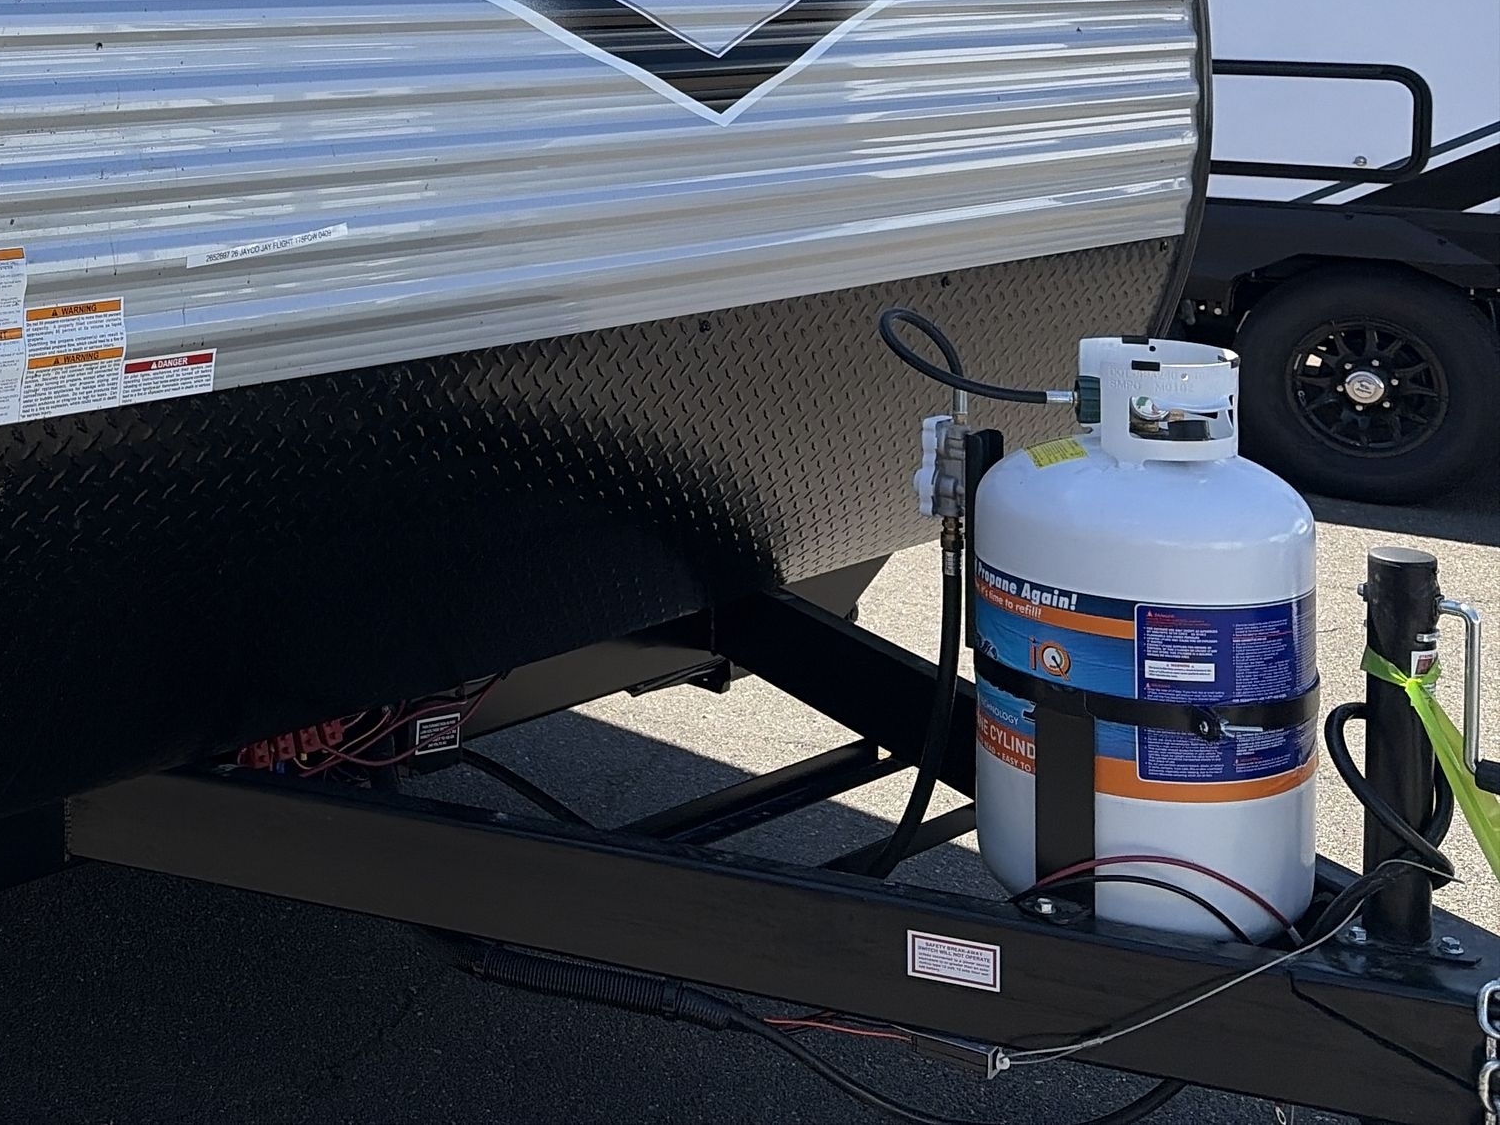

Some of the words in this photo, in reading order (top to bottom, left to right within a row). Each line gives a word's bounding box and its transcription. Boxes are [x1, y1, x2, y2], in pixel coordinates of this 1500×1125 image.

[239, 244, 260, 257] JAYCO
[260, 242, 272, 252] JAY
[273, 238, 293, 250] FLIGHT
[61, 304, 97, 315] WARNING
[64, 352, 99, 363] WARNING
[157, 356, 189, 369] DANGER
[978, 561, 1018, 595] Propane
[1021, 582, 1078, 611] Again!
[1004, 596, 1014, 610] to
[1015, 603, 1042, 619] refill!
[1002, 754, 1019, 767] EASY
[1020, 761, 1032, 772] TO
[925, 942, 945, 950] SAFETY
[947, 946, 982, 956] BREAK-AWAY
[965, 955, 990, 963] OPERATE
